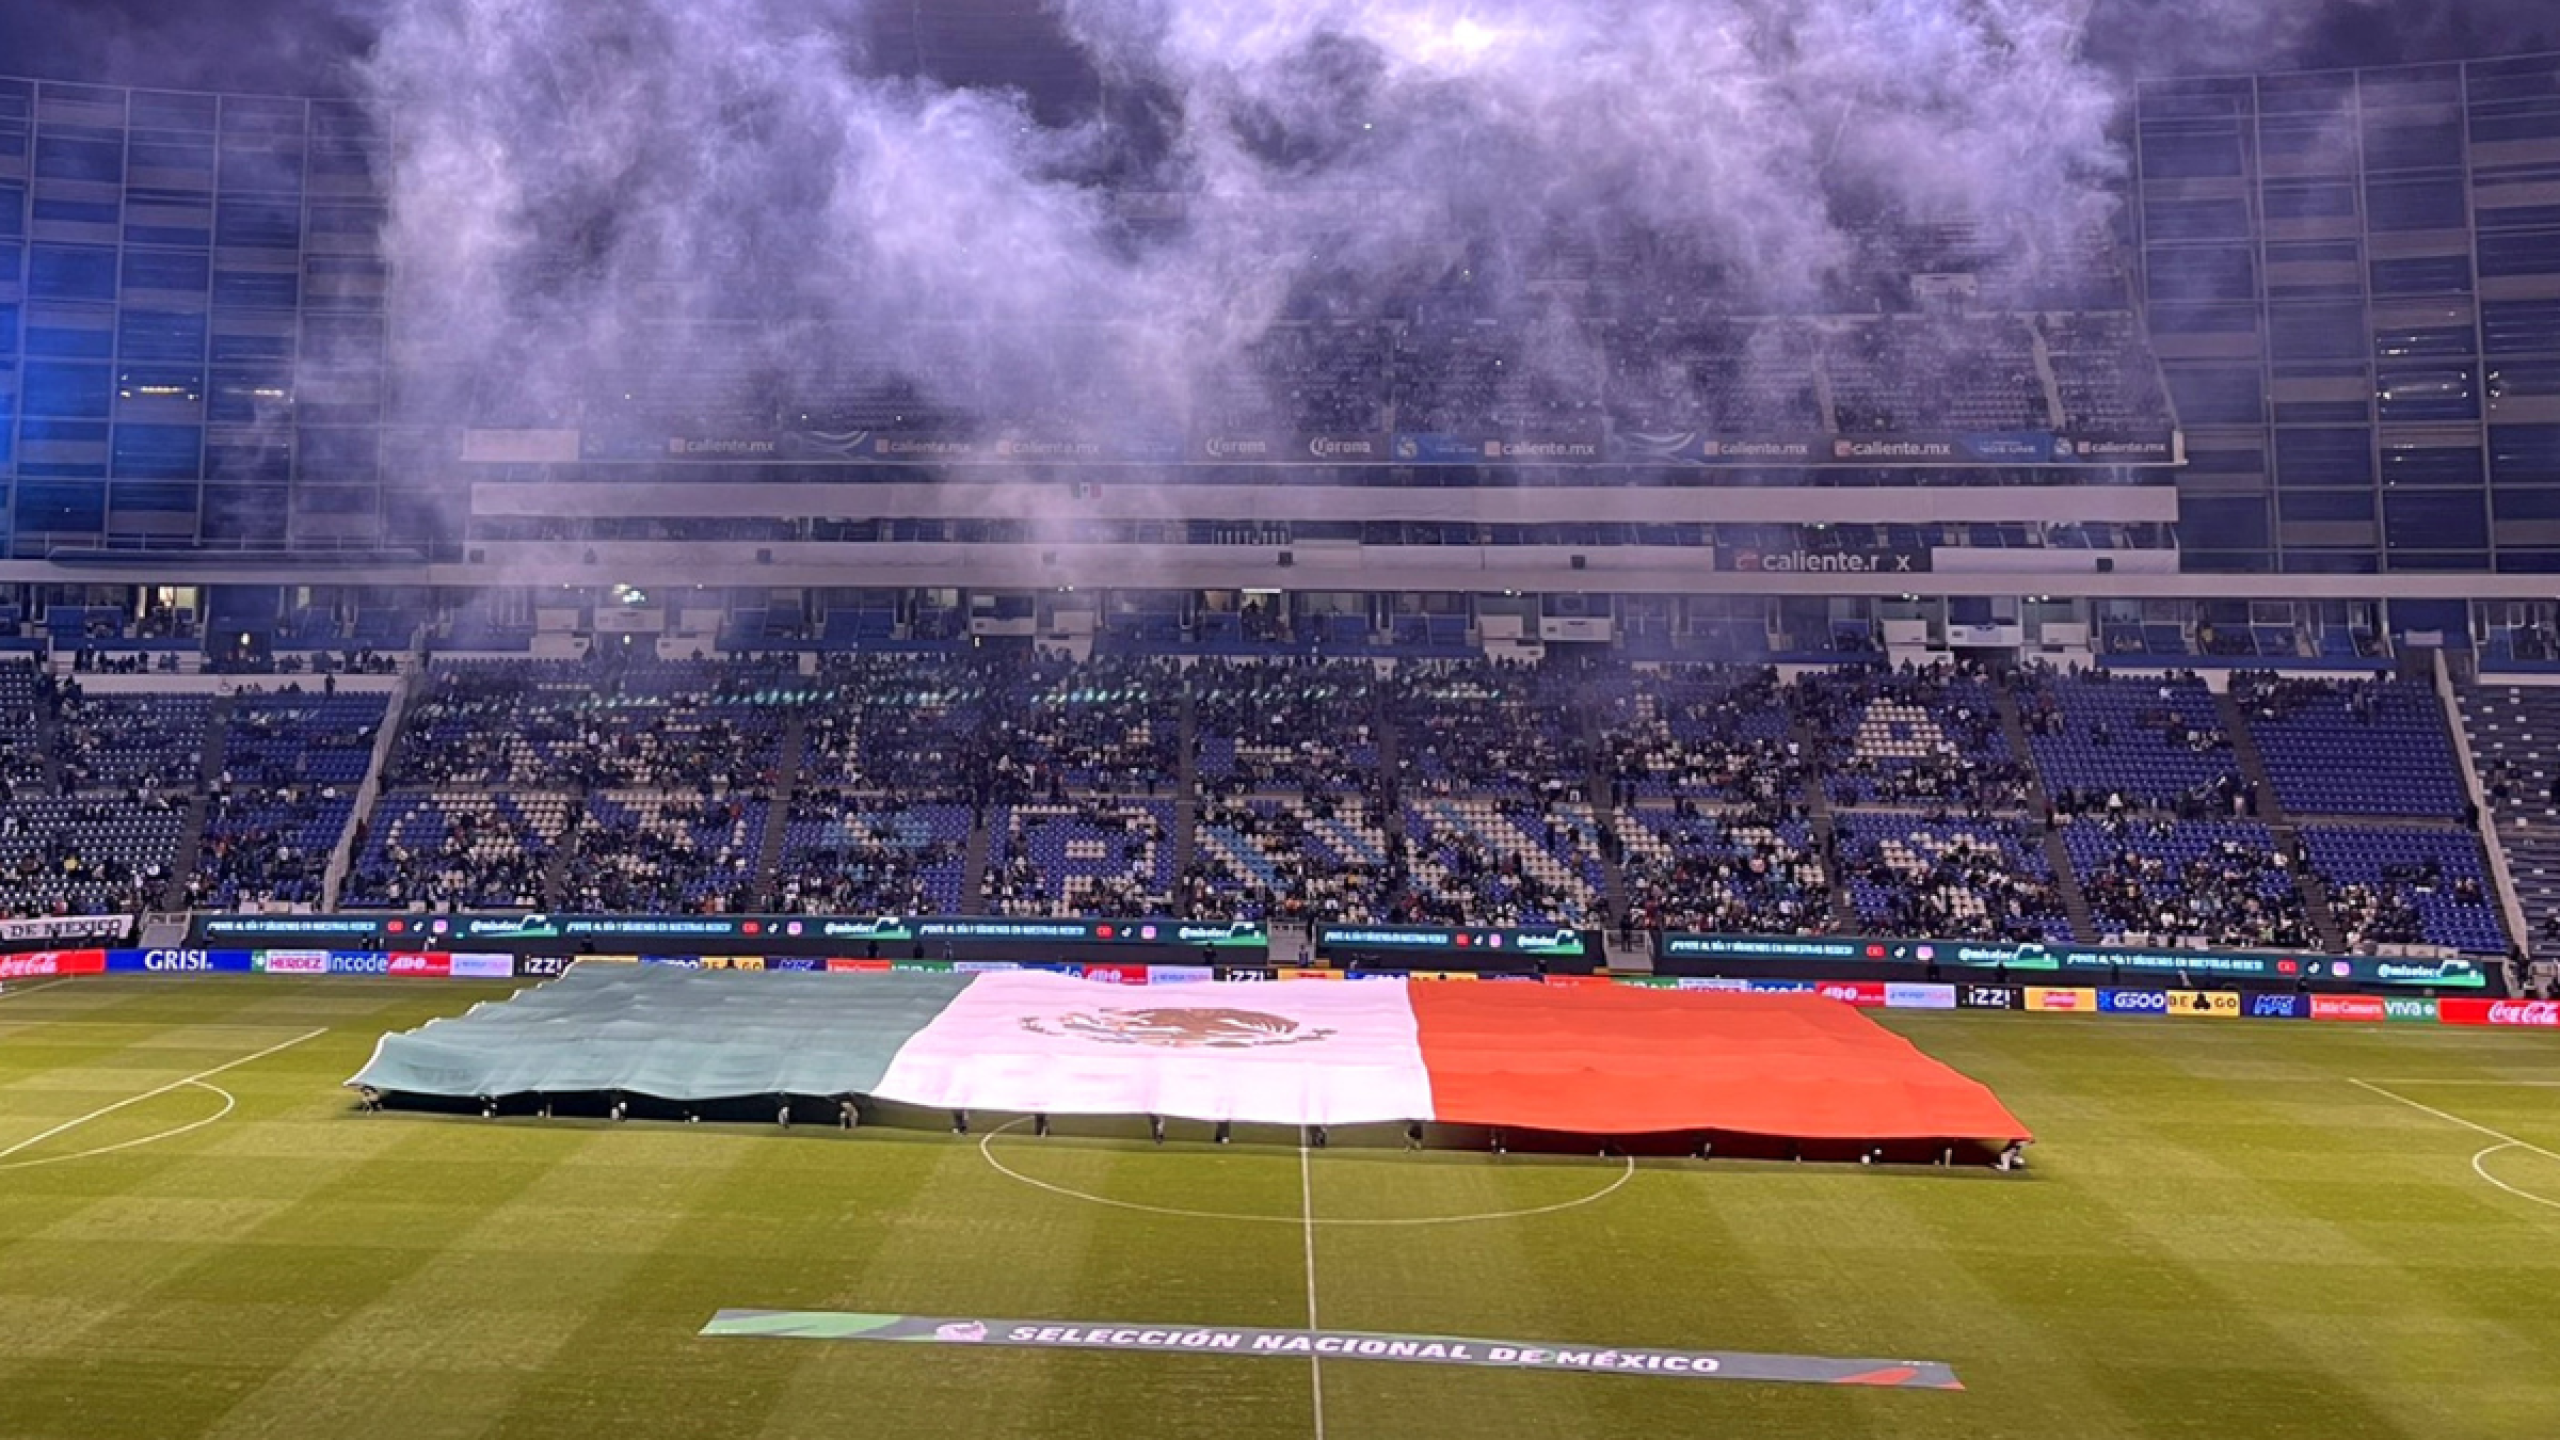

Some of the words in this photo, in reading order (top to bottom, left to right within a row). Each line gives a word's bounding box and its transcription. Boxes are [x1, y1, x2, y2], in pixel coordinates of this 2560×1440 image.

[1206, 439, 1266, 457] Corona
[1310, 437, 1372, 457] Corona
[1502, 441, 1595, 455] caliente.mx
[1721, 441, 1807, 455] caliente.mx
[1853, 441, 1950, 456] caliente.mx
[2093, 441, 2166, 454] caliente.mx
[270, 957, 322, 971] HERDEZ
[2213, 997, 2237, 1008] GO
[2488, 1001, 2559, 1024] Coca-Cola
[1008, 1326, 1242, 1349] SELECCIÓN
[1251, 1335, 1474, 1360] NACIONAL
[1488, 1348, 1543, 1364] DE
[1556, 1350, 1720, 1373] MÉXICO
